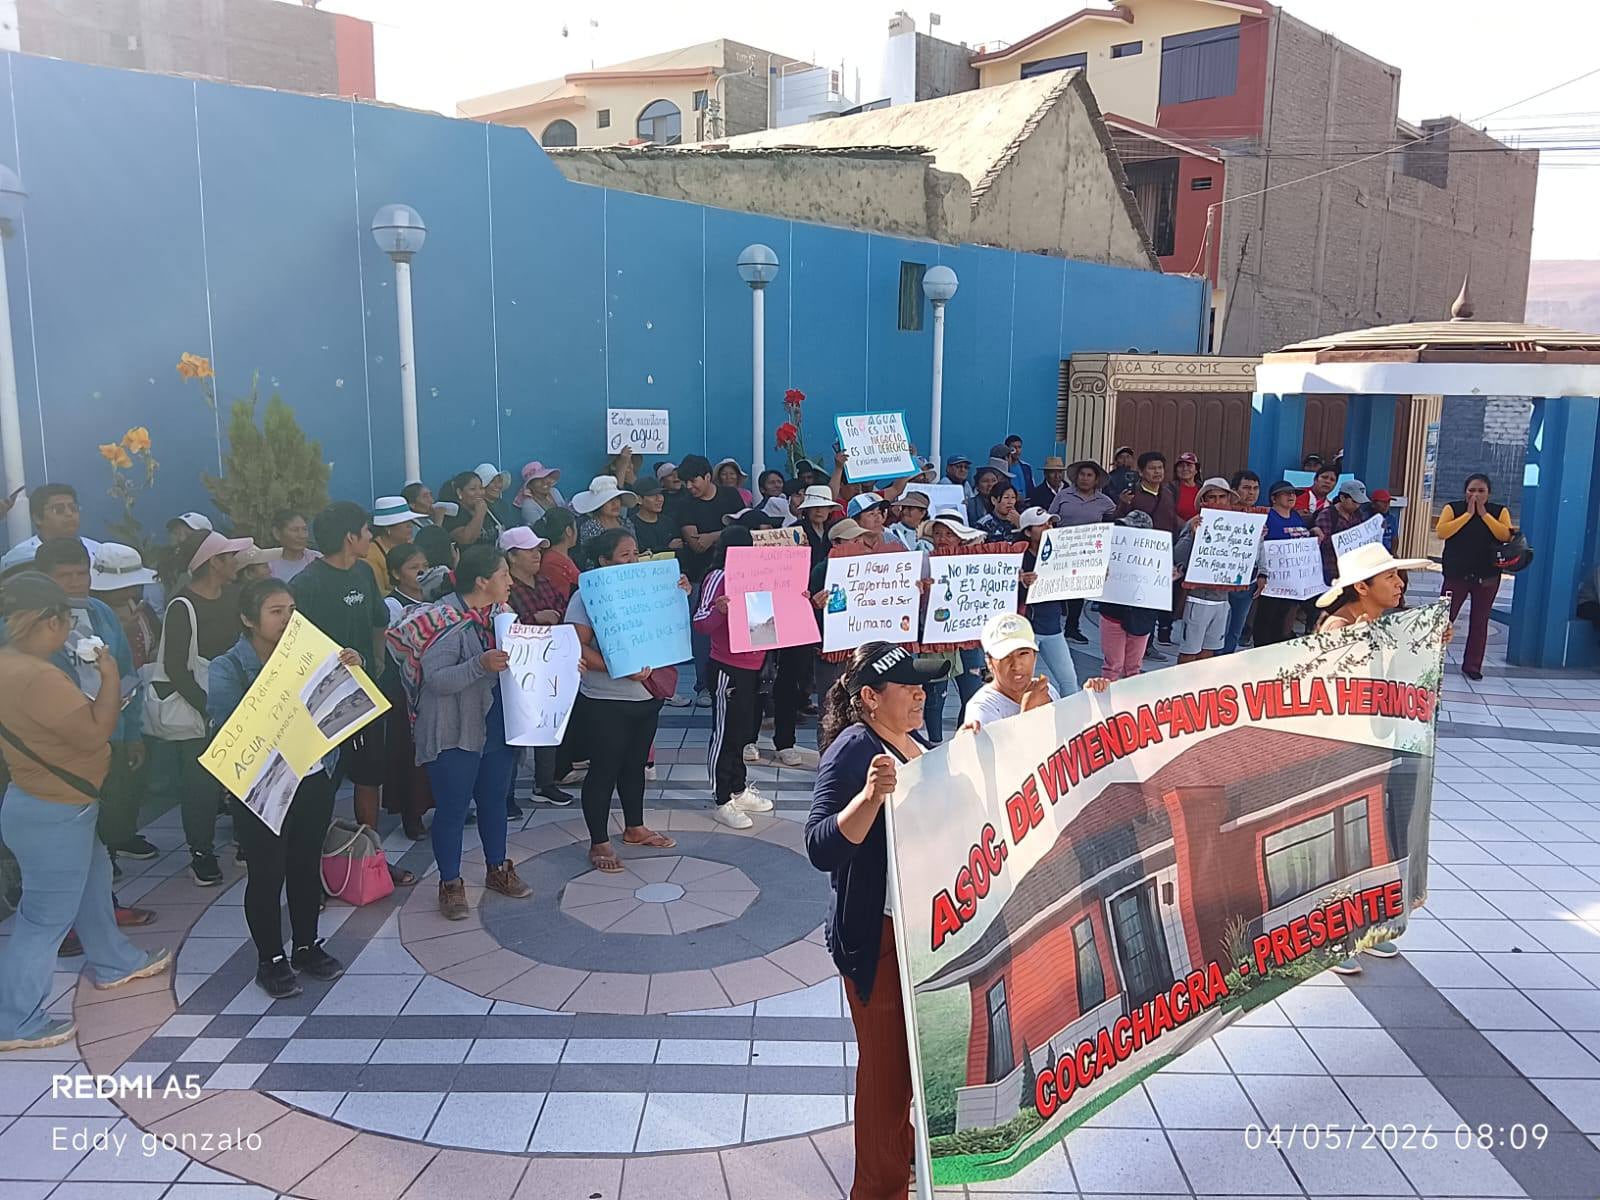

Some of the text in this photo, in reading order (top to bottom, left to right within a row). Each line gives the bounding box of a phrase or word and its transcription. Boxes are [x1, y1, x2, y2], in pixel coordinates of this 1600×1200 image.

[1175, 363, 1221, 373] COME
[868, 414, 896, 425] AGUA
[630, 428, 661, 448] agua
[865, 561, 889, 574] AGUA
[1072, 558, 1103, 568] HERMOSA
[1127, 554, 1154, 567] CALLA
[948, 563, 961, 578] No
[848, 573, 911, 594] Importante
[854, 593, 876, 607] Para
[848, 616, 892, 632] Humano
[233, 735, 267, 780] AGUA
[931, 822, 1009, 951] ASOC.
[1005, 773, 1045, 846] DE
[1039, 704, 1162, 806] VIVIENDA
[1243, 678, 1333, 722] VILLA
[1035, 961, 1229, 1119] COCACHACRA
[1252, 880, 1404, 976] PRESENTE
